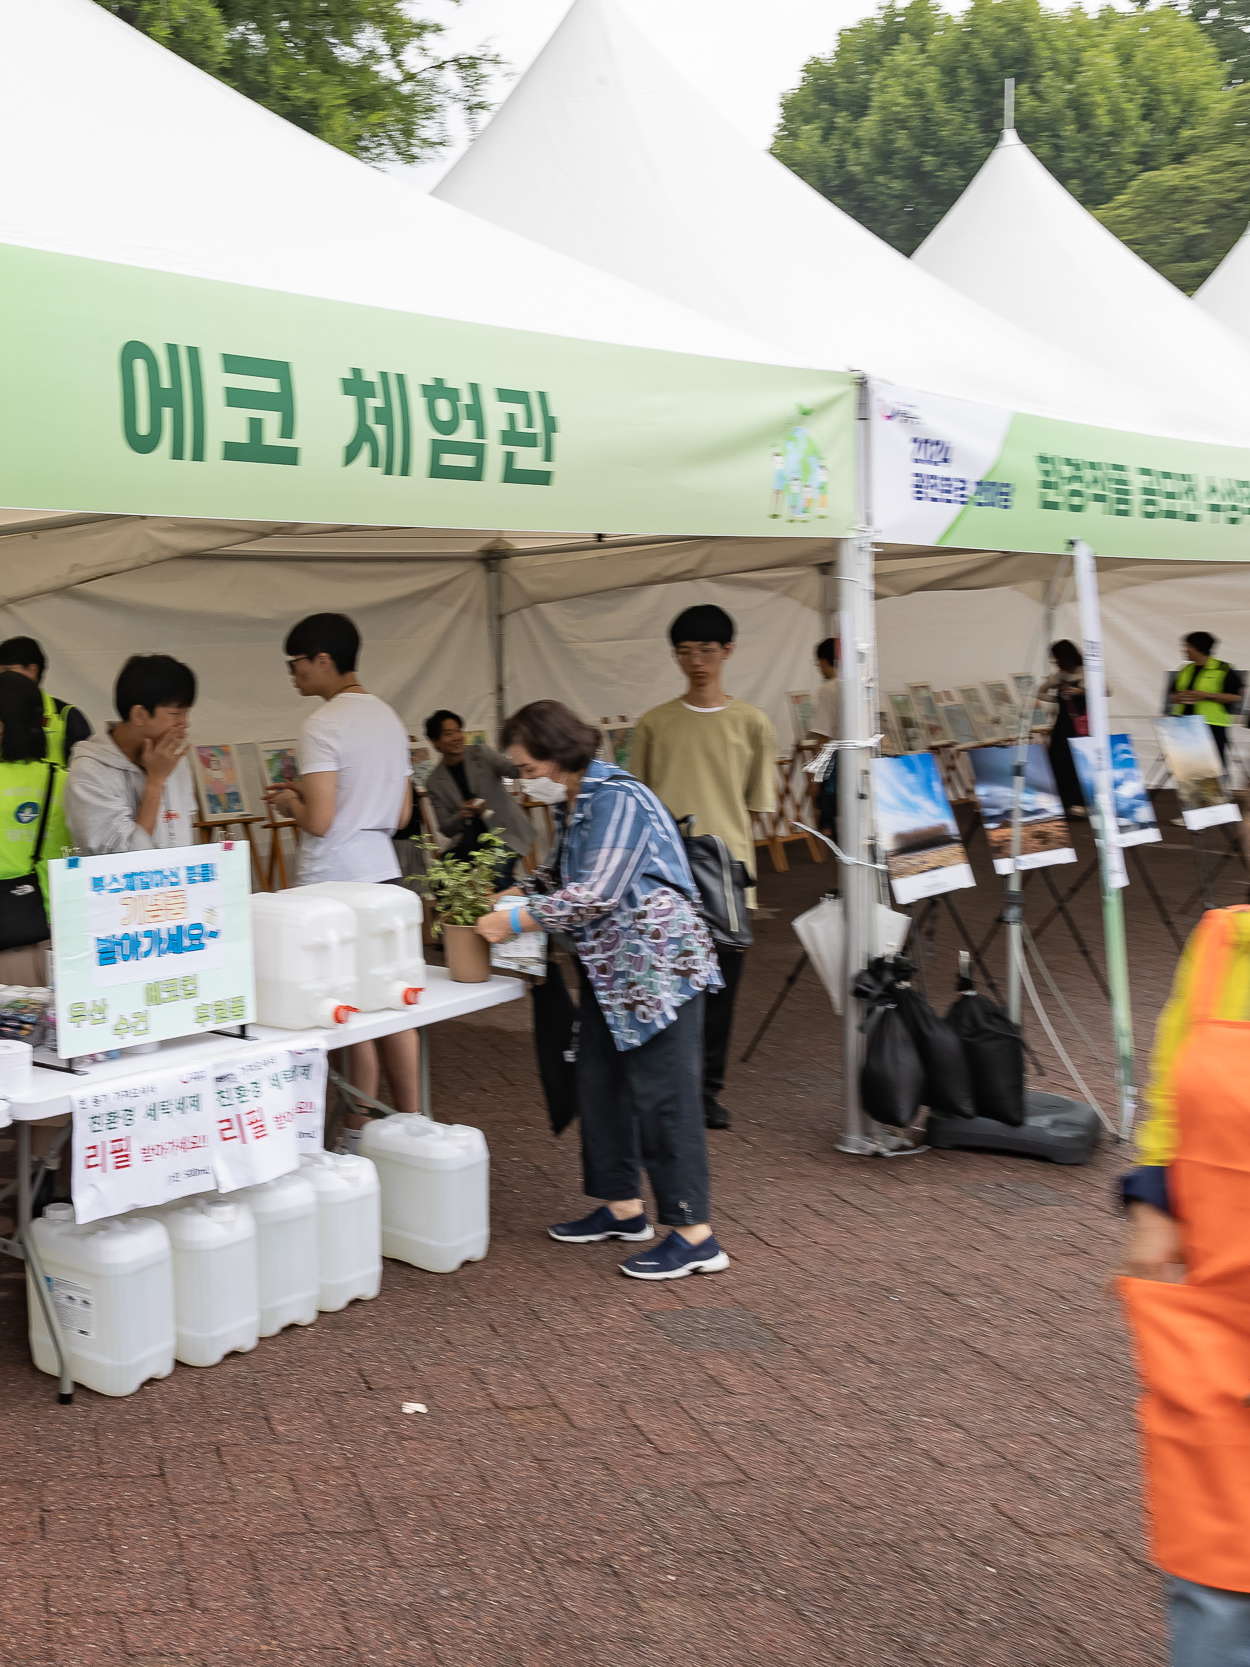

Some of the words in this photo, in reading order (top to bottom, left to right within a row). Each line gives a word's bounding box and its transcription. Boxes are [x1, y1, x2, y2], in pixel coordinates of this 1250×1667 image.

[119, 339, 301, 467] 에코
[340, 365, 559, 487] 체험관
[120, 889, 187, 926] 기념품
[67, 998, 108, 1028] 우산
[216, 1106, 270, 1145] 리필
[84, 1135, 133, 1174] 리필
